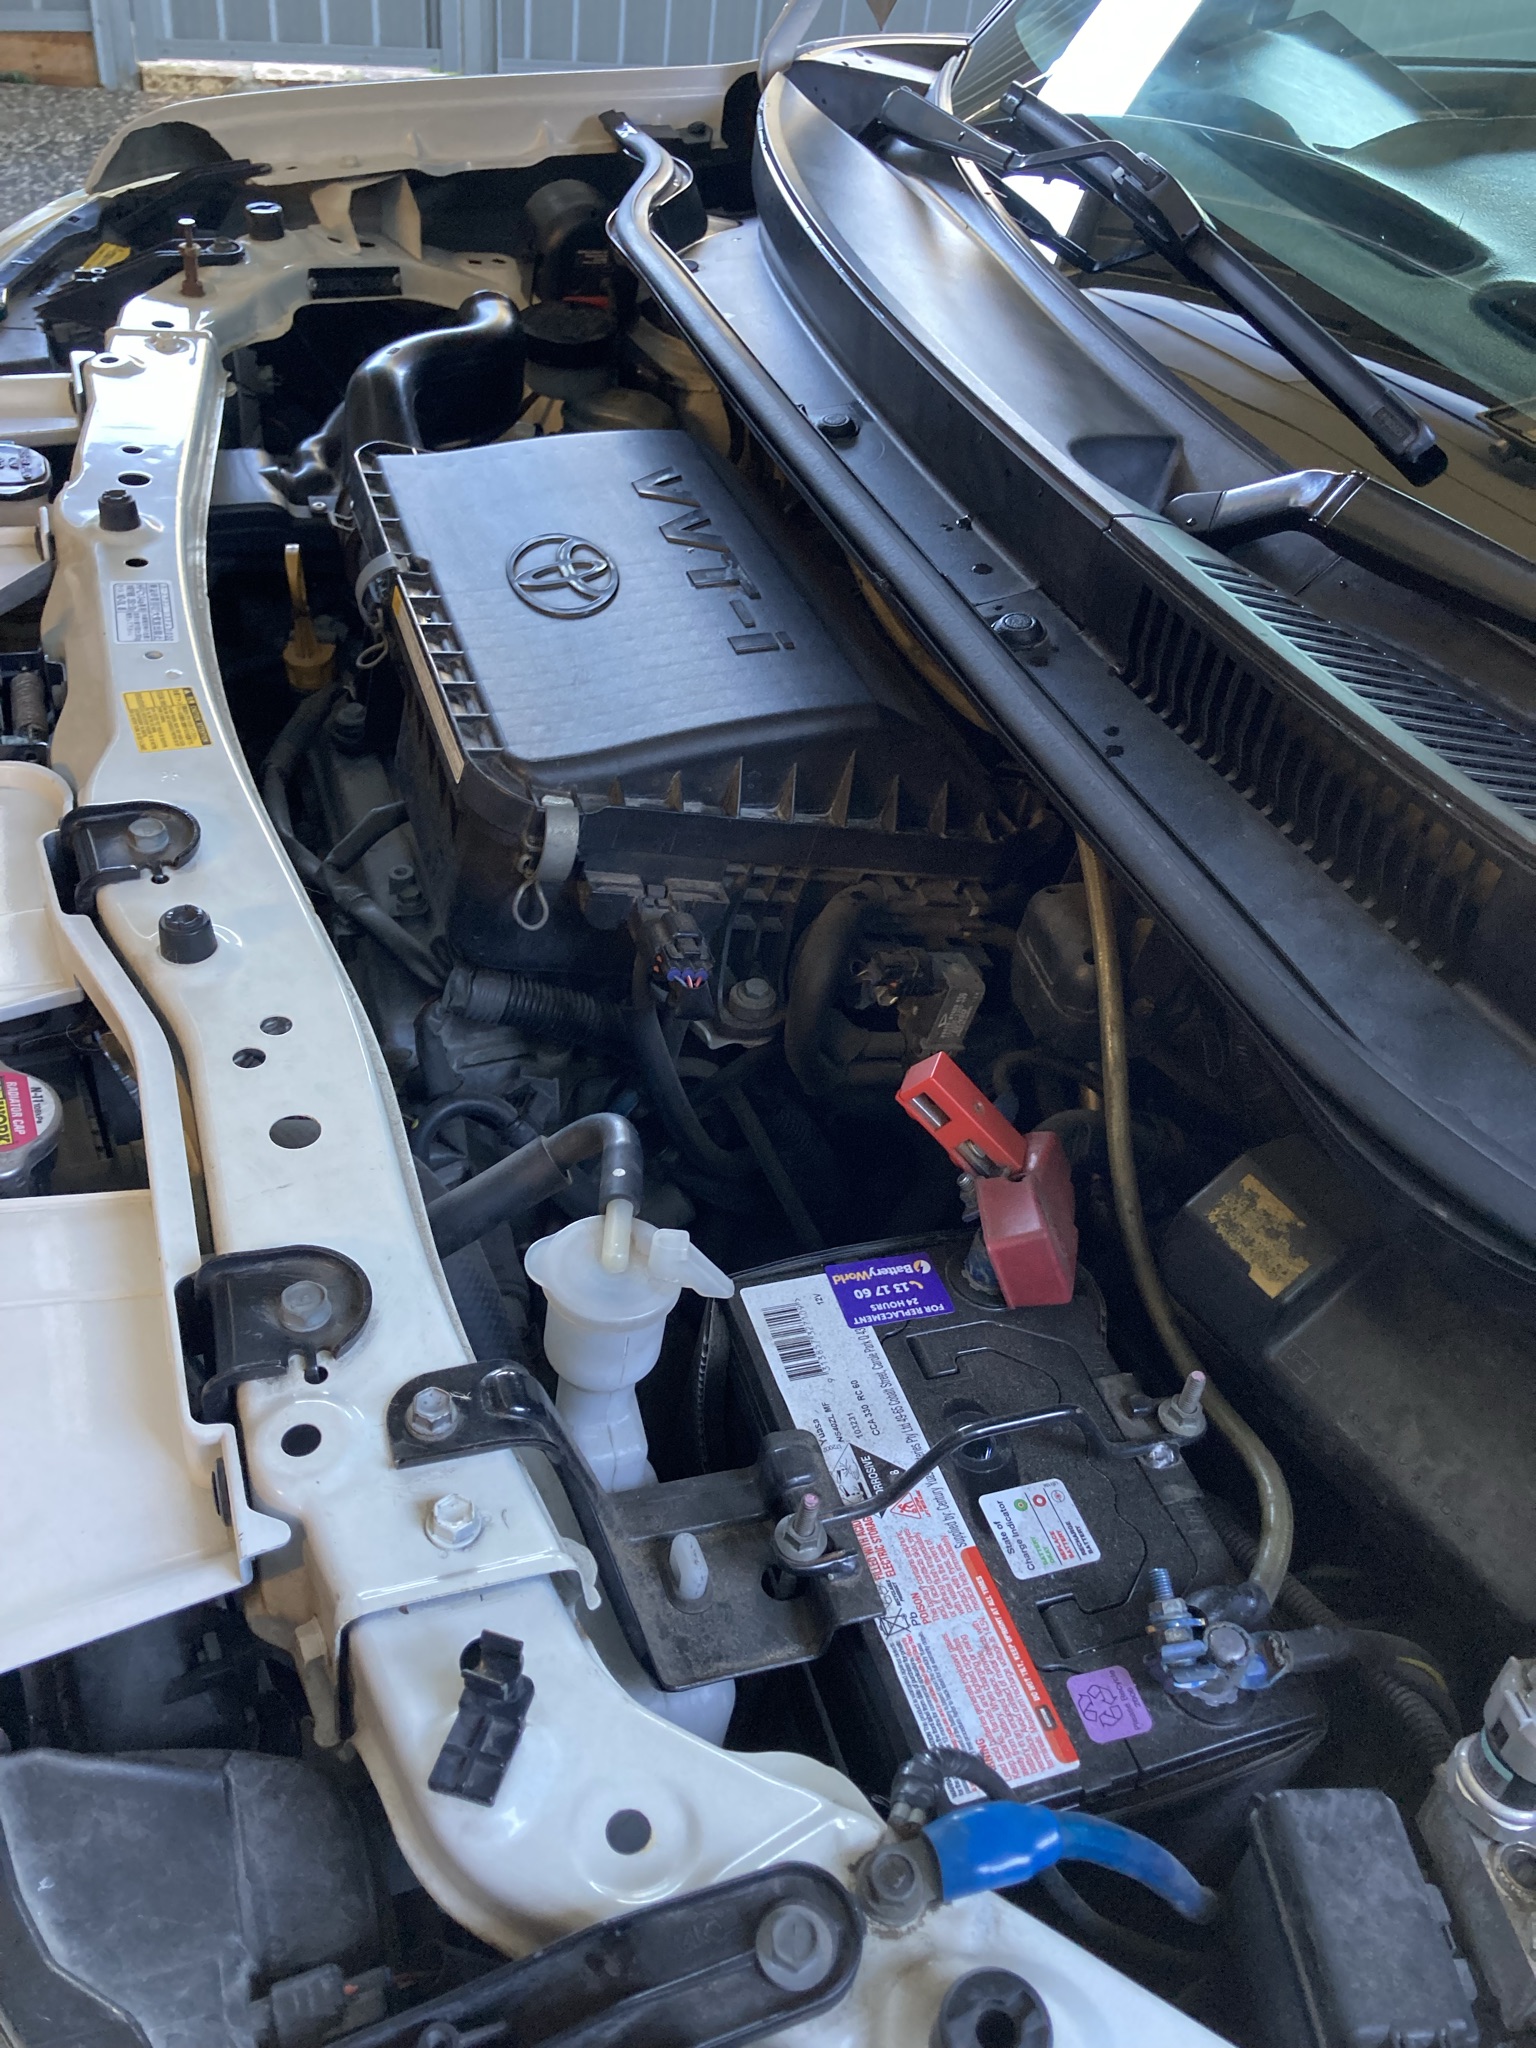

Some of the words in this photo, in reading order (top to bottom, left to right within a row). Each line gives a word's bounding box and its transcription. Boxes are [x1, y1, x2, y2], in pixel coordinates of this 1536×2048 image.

[631, 466, 796, 656] VVT-i
[6, 1082, 23, 1117] RADIATOR
[31, 1087, 44, 1102] N-11
[13, 1120, 26, 1135] CAP
[852, 1287, 873, 1299] 60
[873, 1285, 892, 1296] 17
[892, 1282, 911, 1293] 13
[813, 1293, 824, 1305] 12V
[870, 1299, 905, 1312] HOURS
[905, 1297, 919, 1306] 24
[852, 1305, 923, 1327] REPLACEMENT
[923, 1303, 945, 1313] FOR
[850, 1380, 860, 1389] 60
[854, 1390, 865, 1401] RC
[821, 1402, 832, 1412] MF
[861, 1405, 873, 1418] 330
[812, 1419, 828, 1445] Yuasa
[827, 1415, 844, 1442] NS40ZL
[847, 1413, 863, 1438] 103231
[868, 1419, 881, 1435] CCA
[861, 1456, 885, 1494] RROSIVE
[993, 1520, 1004, 1530] of
[994, 1500, 1020, 1537] Indicator
[863, 1516, 882, 1543] STORAG
[859, 1538, 874, 1555] WITH
[998, 1532, 1016, 1554] State
[875, 1545, 896, 1577] ELECTRIC
[1014, 1539, 1038, 1571] Charge
[867, 1557, 884, 1580] FILLED
[911, 1592, 931, 1624] POISON
[908, 1611, 922, 1627] Pb
[975, 1738, 997, 1772] RNING
